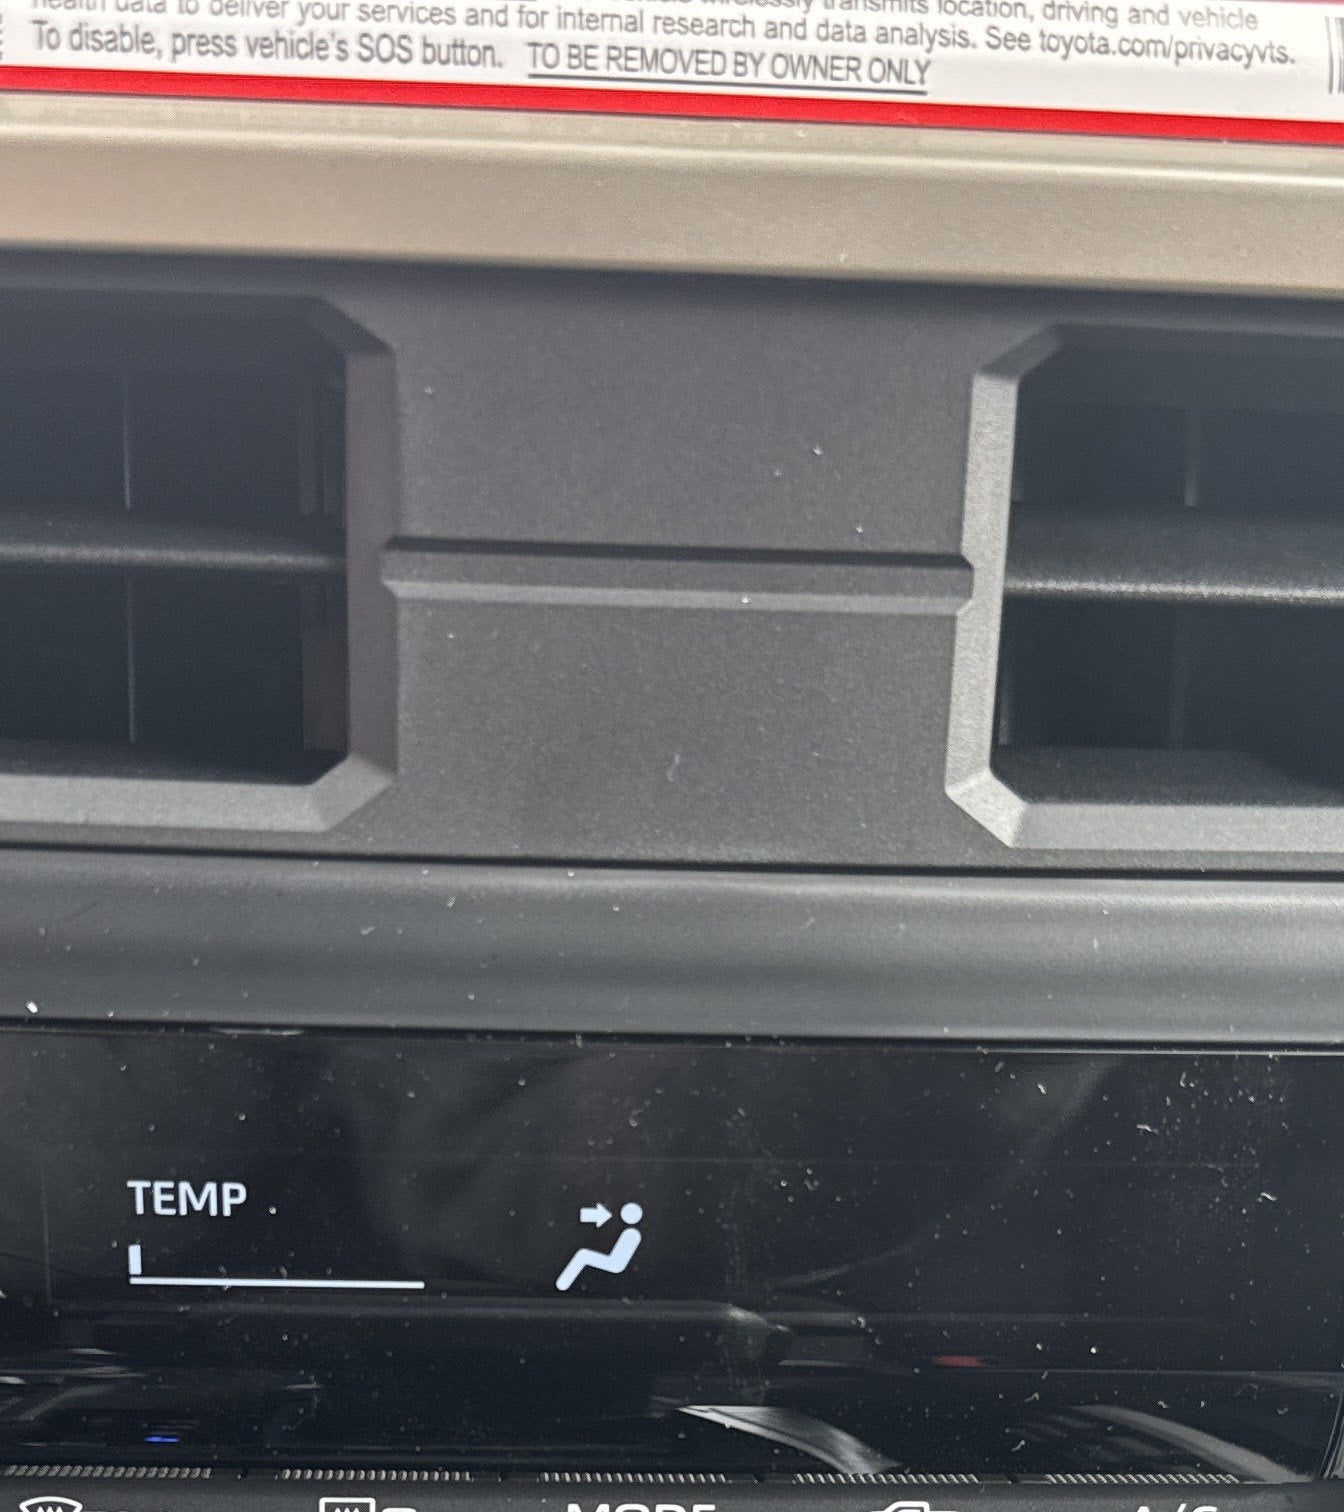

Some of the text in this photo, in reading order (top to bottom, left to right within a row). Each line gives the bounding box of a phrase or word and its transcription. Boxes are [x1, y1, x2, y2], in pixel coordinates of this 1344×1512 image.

[210, 0, 288, 19] deliver
[297, 0, 349, 27] your
[356, 1, 457, 26] services
[465, 5, 509, 28] and
[516, 6, 549, 29] for
[555, 6, 644, 34] internal
[652, 14, 756, 38] research
[763, 18, 807, 41] and
[816, 18, 868, 43] data
[875, 21, 977, 54] analysis.
[985, 25, 1031, 52] See
[1038, 28, 1297, 69] toyota.com/privacyvts.
[937, 0, 1036, 23] location,
[1042, 0, 1118, 29] driving
[1128, 3, 1170, 26] and
[1177, 6, 1259, 31] vehicle
[31, 19, 933, 86] To disable, press vehicle's SOS button. TO BE REMOVED BY OWNER ONLY
[127, 1180, 248, 1217] TEMP
